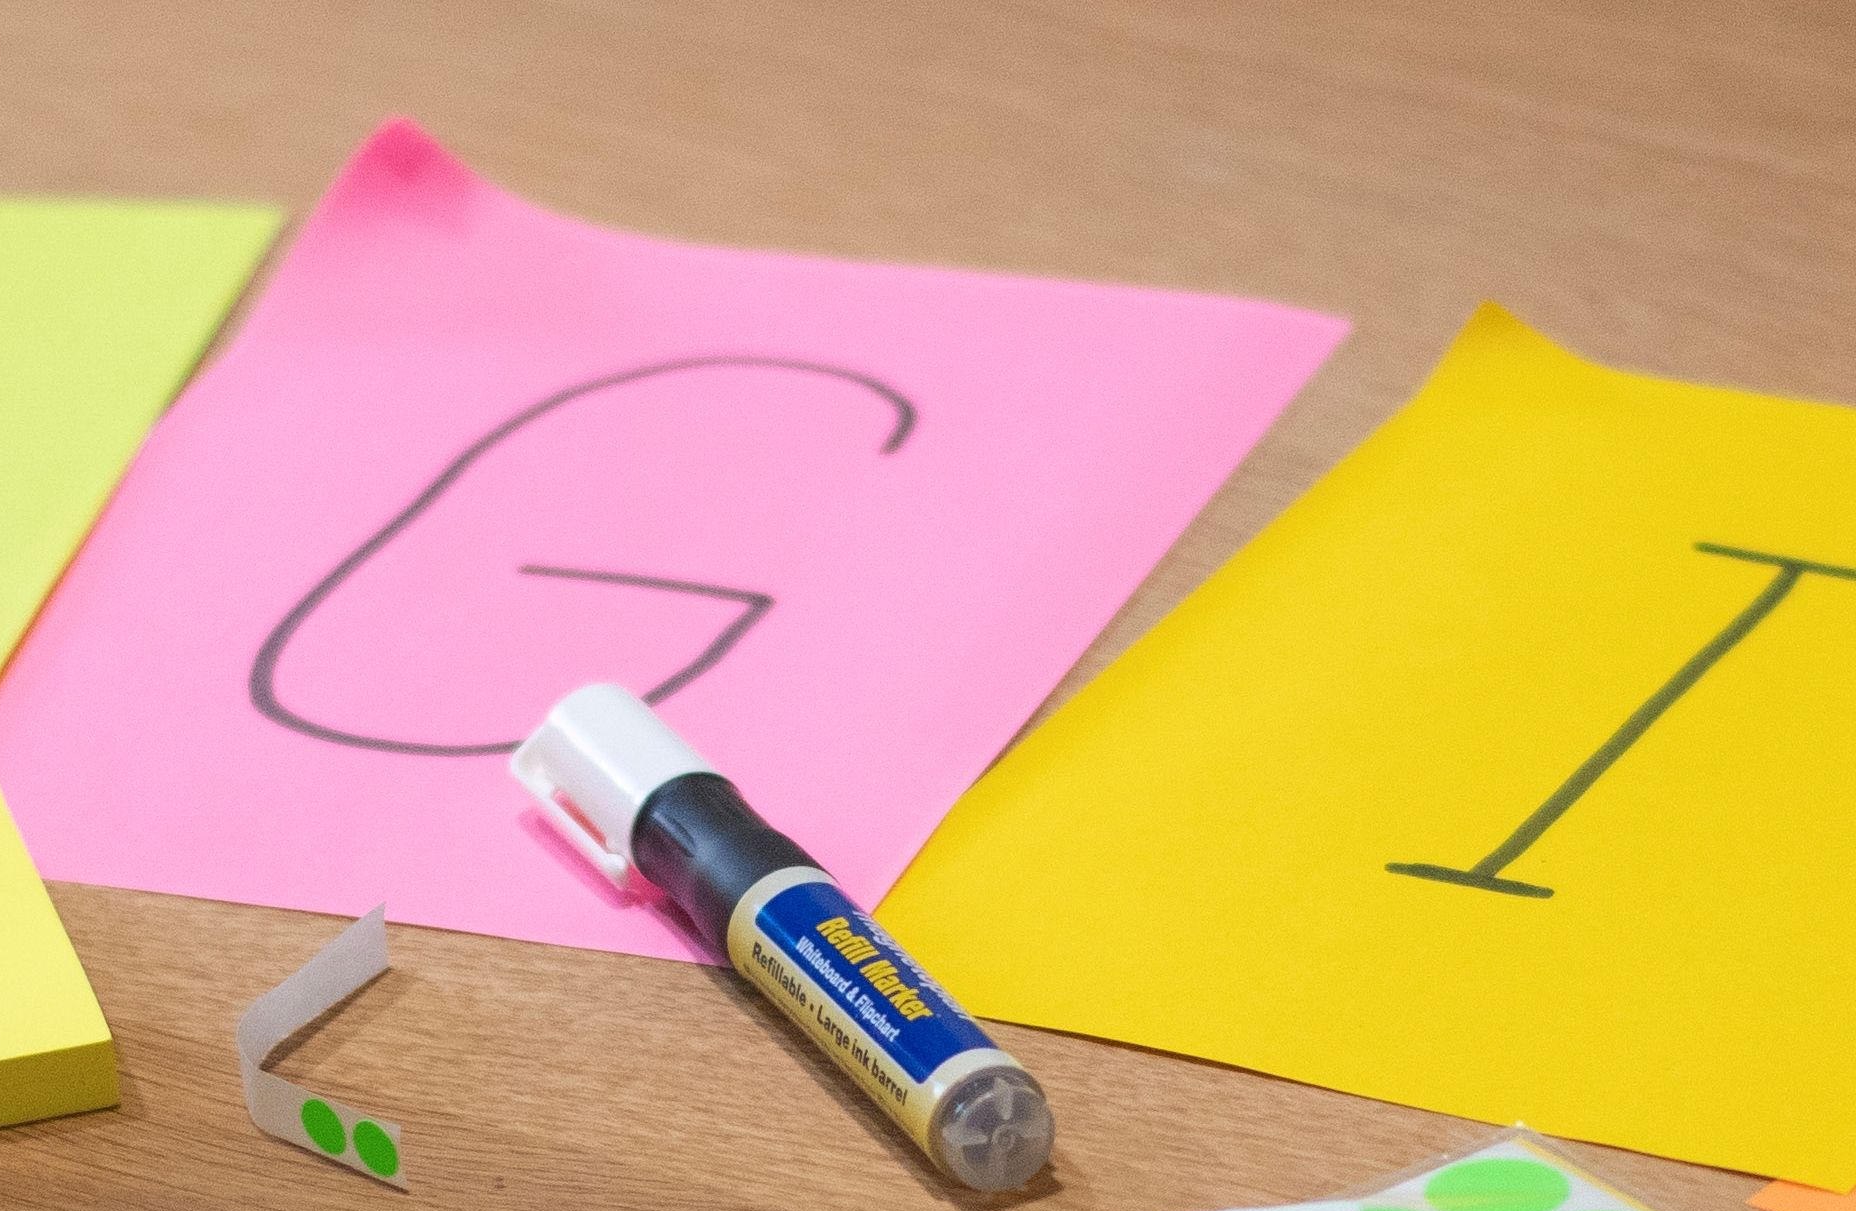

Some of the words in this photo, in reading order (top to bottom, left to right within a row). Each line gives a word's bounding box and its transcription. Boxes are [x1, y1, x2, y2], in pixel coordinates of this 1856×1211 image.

[248, 356, 918, 757] G
[751, 941, 807, 1007] Refillable
[816, 1004, 850, 1046] Large
[850, 1040, 871, 1068] ink
[870, 1062, 908, 1107] barrel
[795, 935, 853, 995] Whiteboard
[845, 986, 857, 1004] &
[854, 994, 900, 1044] Flipchart
[816, 916, 880, 966] Refill
[859, 959, 933, 1022] Marker
